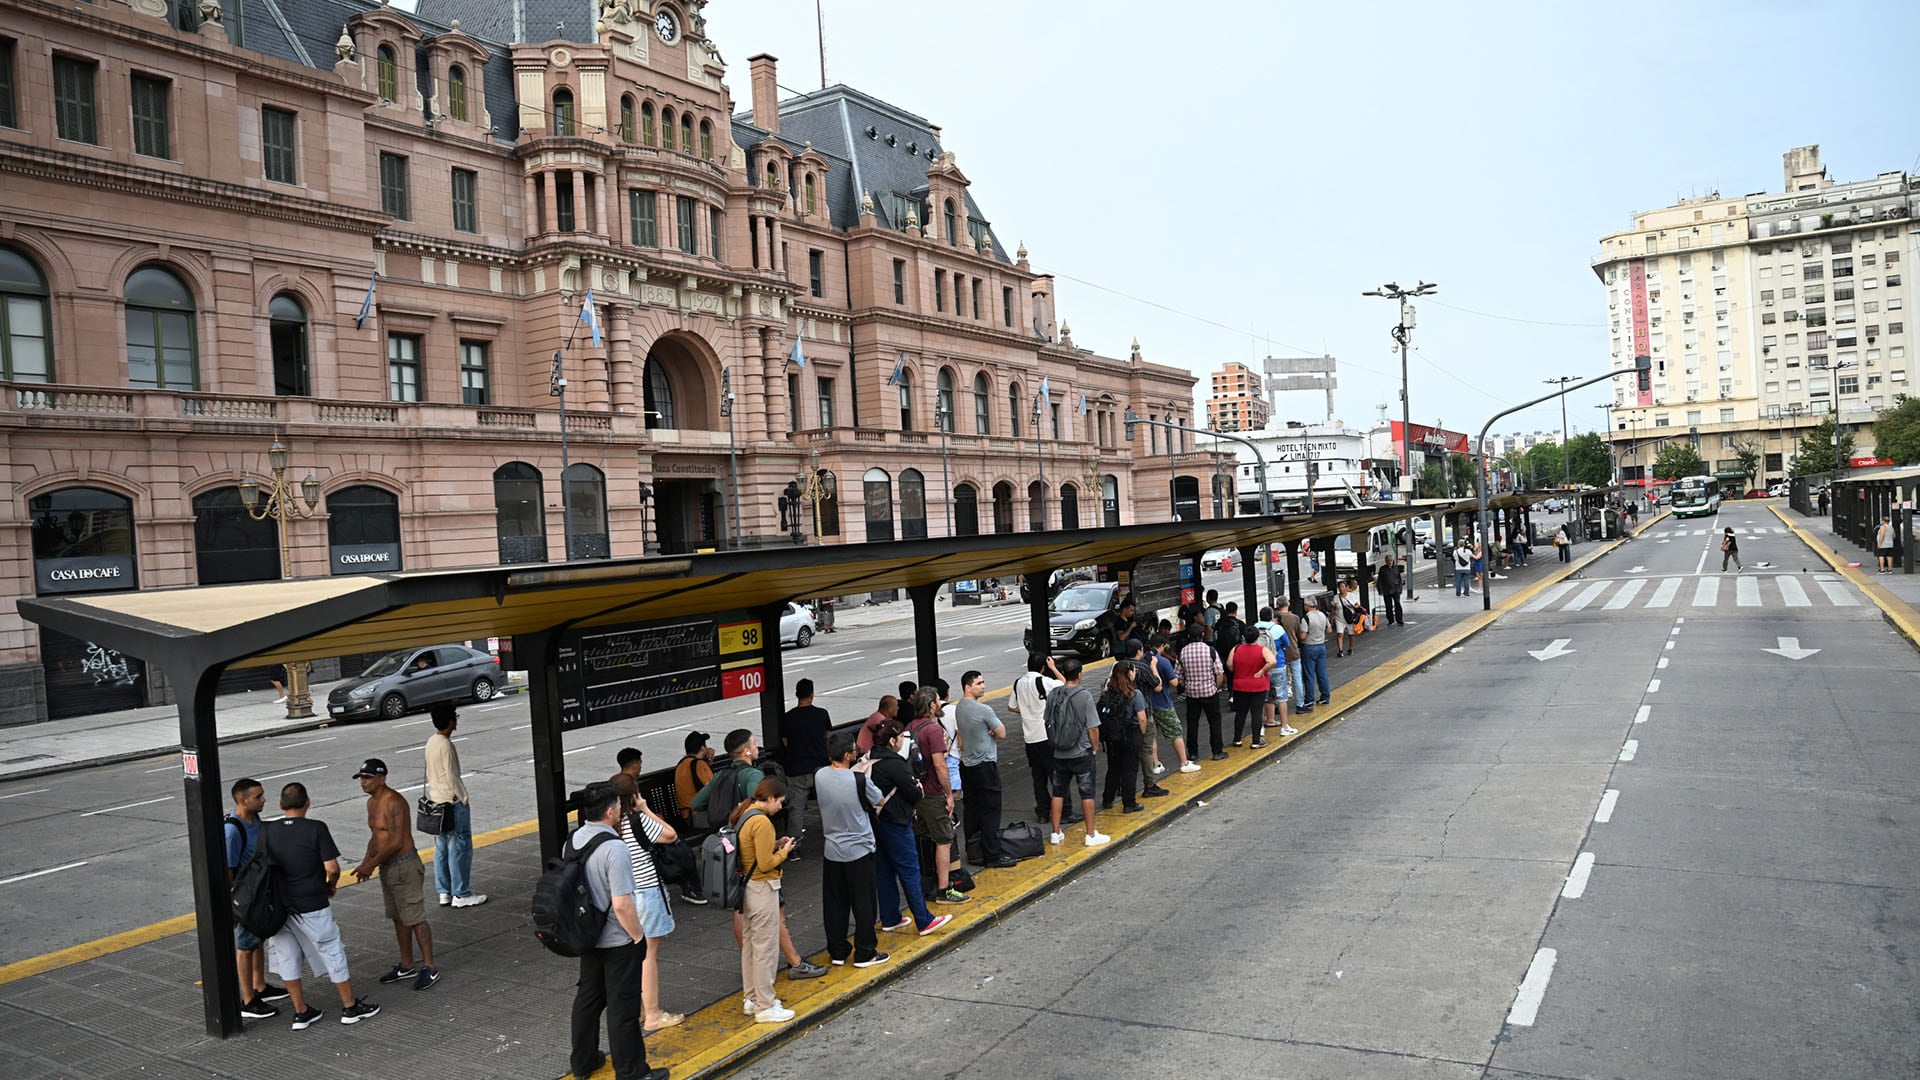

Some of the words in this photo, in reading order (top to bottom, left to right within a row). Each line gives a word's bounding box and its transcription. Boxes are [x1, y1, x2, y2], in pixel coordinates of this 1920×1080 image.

[643, 286, 673, 304] 1885
[693, 294, 720, 310] 1907
[1277, 444, 1298, 452] HOTEL
[1318, 442, 1336, 450] MIXTO
[1290, 452, 1306, 460] LIMA
[672, 463, 716, 473] Constitución
[341, 554, 360, 564] CASA
[51, 569, 79, 581] CASA
[79, 569, 93, 579] DO
[742, 628, 758, 646] 98
[739, 671, 761, 691] 100
[184, 755, 197, 773] 100
